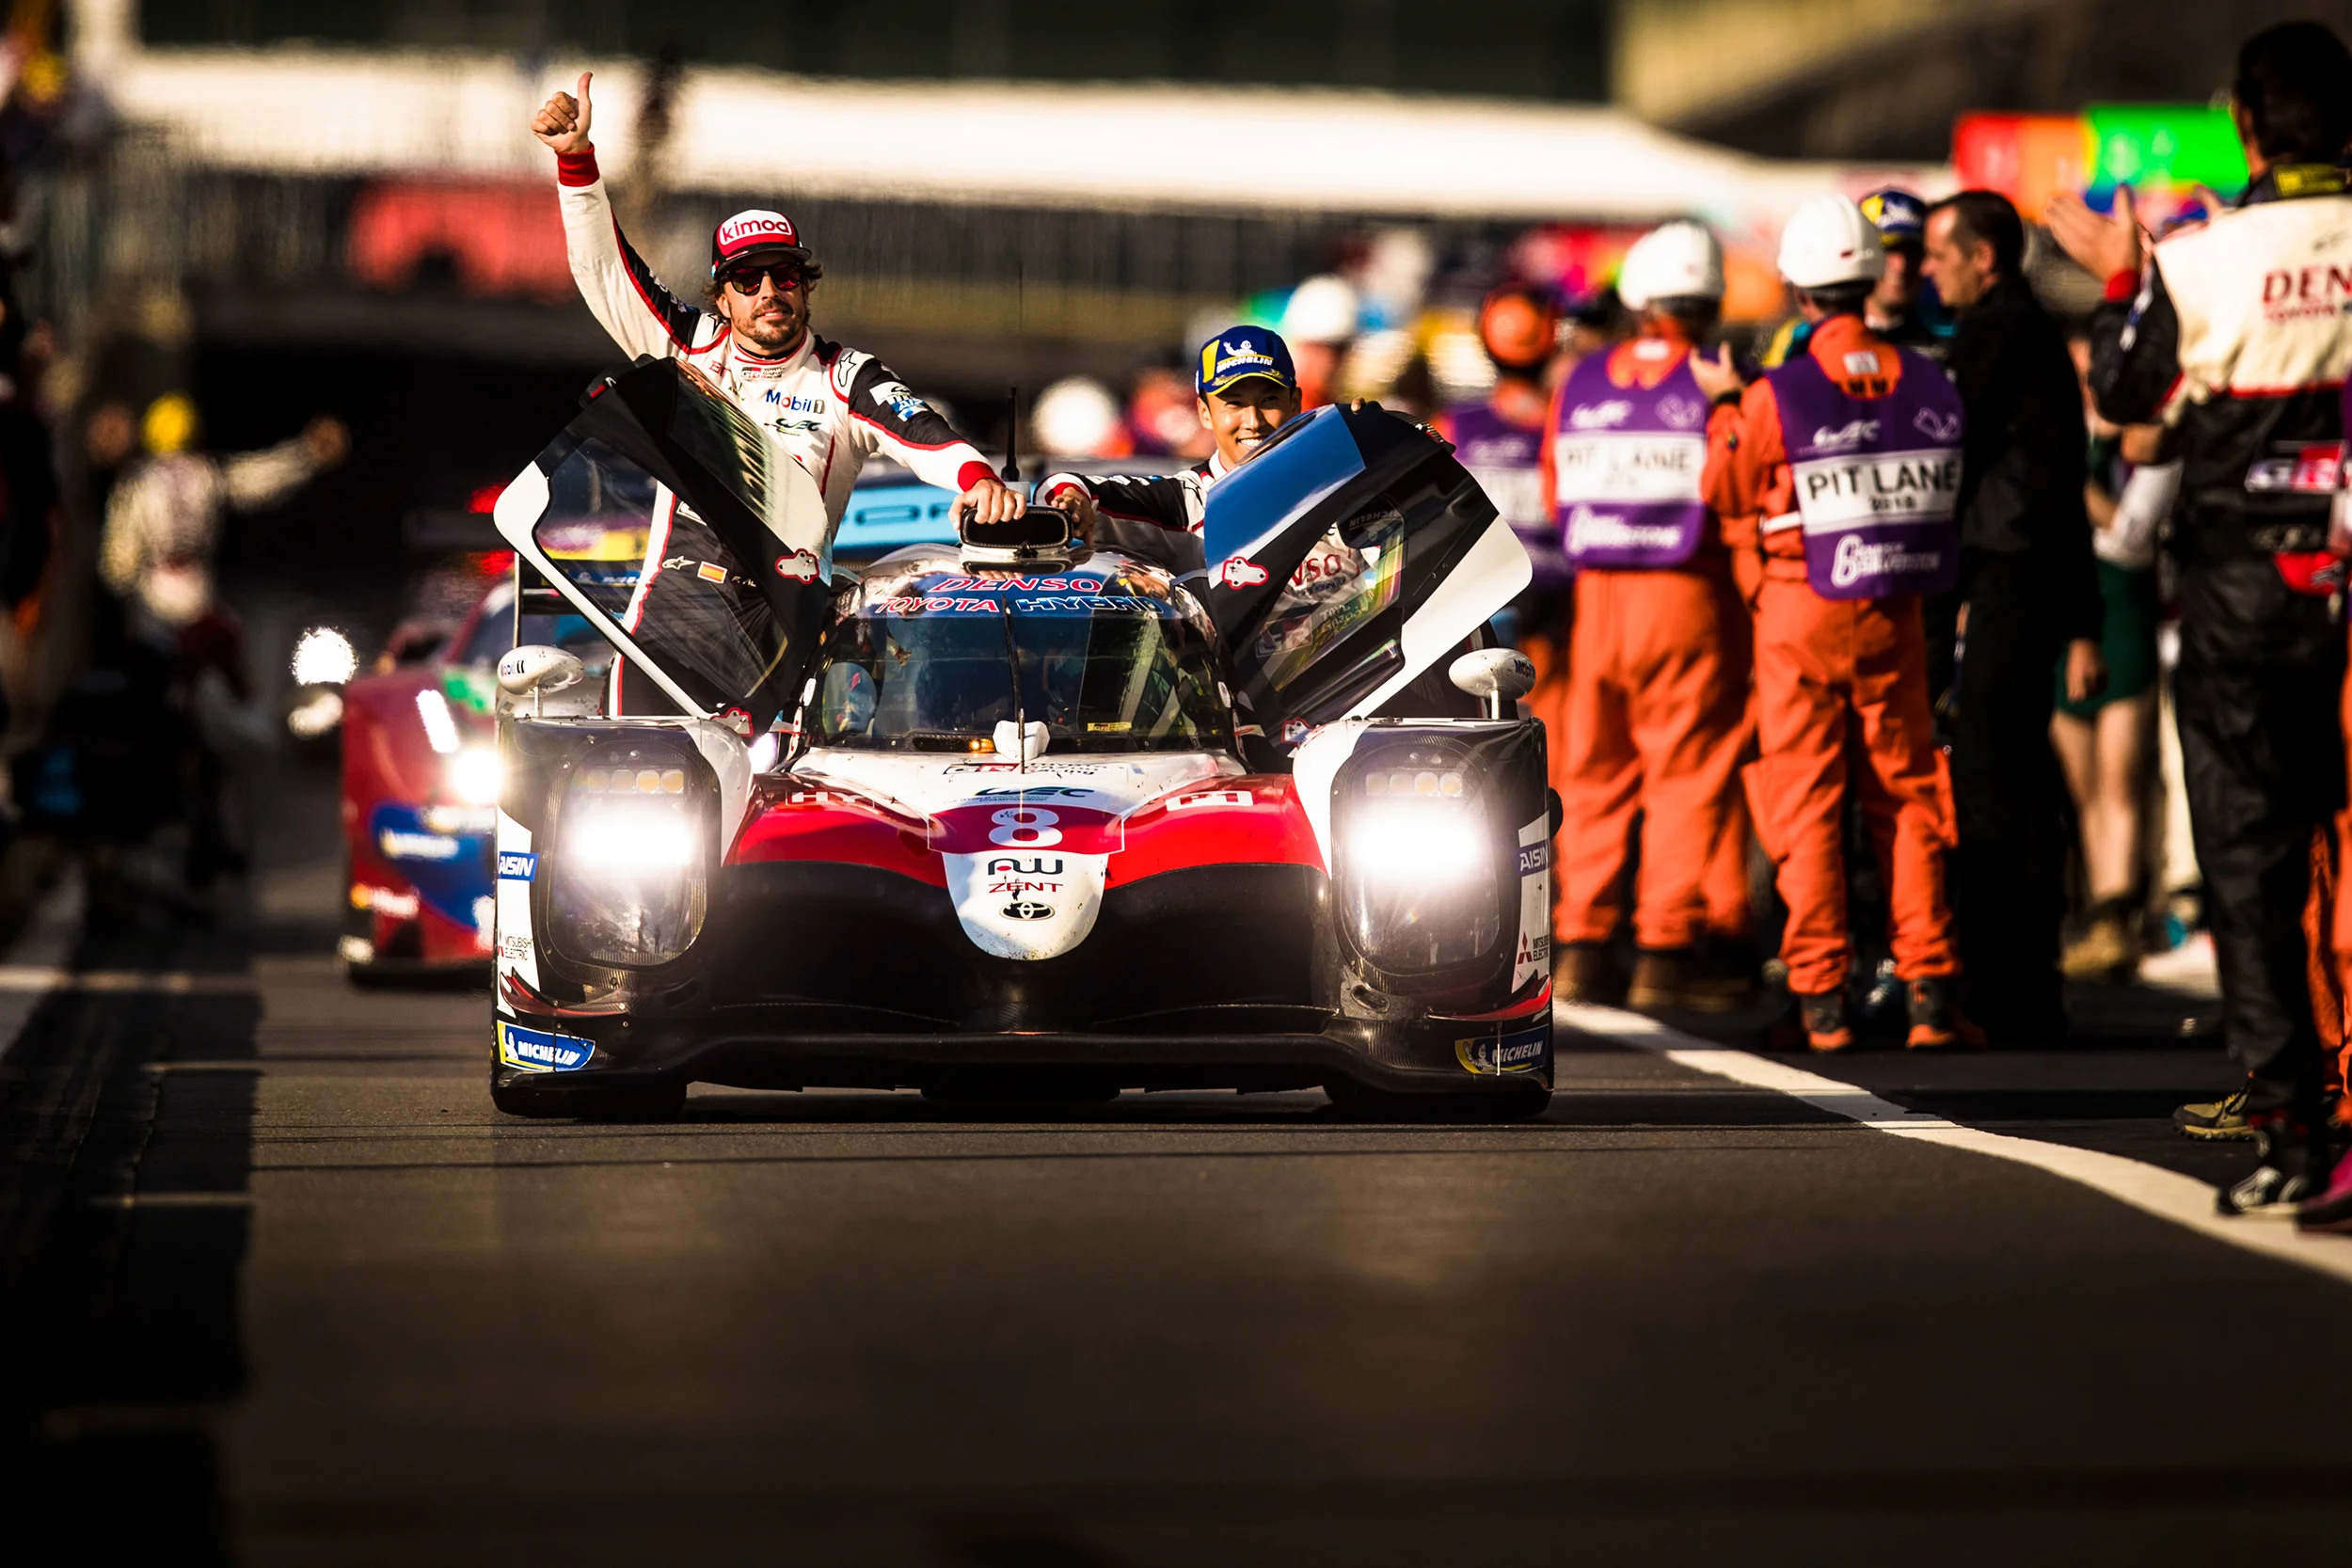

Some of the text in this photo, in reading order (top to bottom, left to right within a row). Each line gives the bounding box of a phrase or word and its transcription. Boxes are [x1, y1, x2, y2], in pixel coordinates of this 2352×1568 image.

[723, 219, 790, 243] kimoa
[1216, 356, 1273, 373] MICHELIN
[766, 389, 812, 412] Mobil
[1806, 458, 1958, 501] PIT LANE
[928, 578, 1104, 593] DENSO
[875, 596, 1164, 613] TOYOTA HYBRID
[975, 786, 1095, 798] WEC
[989, 807, 1063, 847] 8
[499, 856, 534, 877] AISIN
[1519, 846, 1549, 872] AISIN
[989, 882, 1064, 894] ZENT
[518, 1040, 580, 1066] MICHELIN
[1492, 1040, 1543, 1064] MICHELIN
